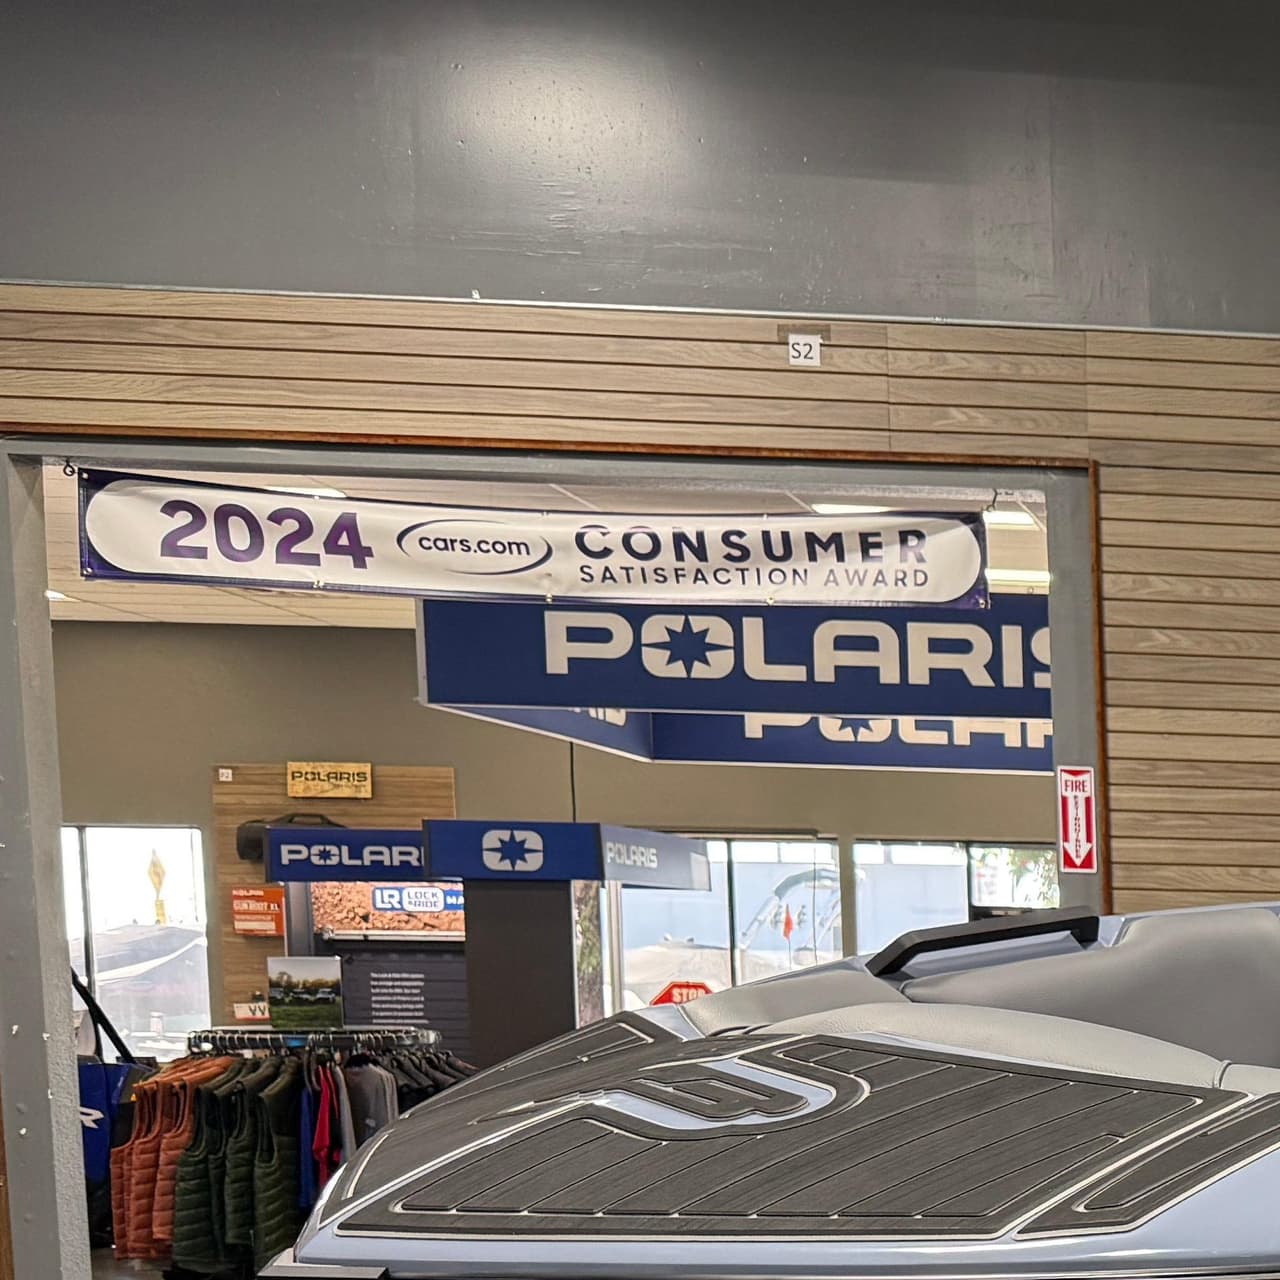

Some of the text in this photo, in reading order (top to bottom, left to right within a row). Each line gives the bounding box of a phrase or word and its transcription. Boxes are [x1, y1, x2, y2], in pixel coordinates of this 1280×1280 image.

[791, 342, 814, 360] S2
[159, 499, 374, 569] 2024
[418, 533, 530, 557] cars.com
[574, 524, 928, 565] CONSUMER
[579, 564, 929, 588] SATISFACTION AWARD
[544, 610, 1051, 688] POLARI
[291, 770, 368, 783] POLARIS
[1064, 779, 1087, 793] FIRE
[606, 842, 658, 869] POLARIS
